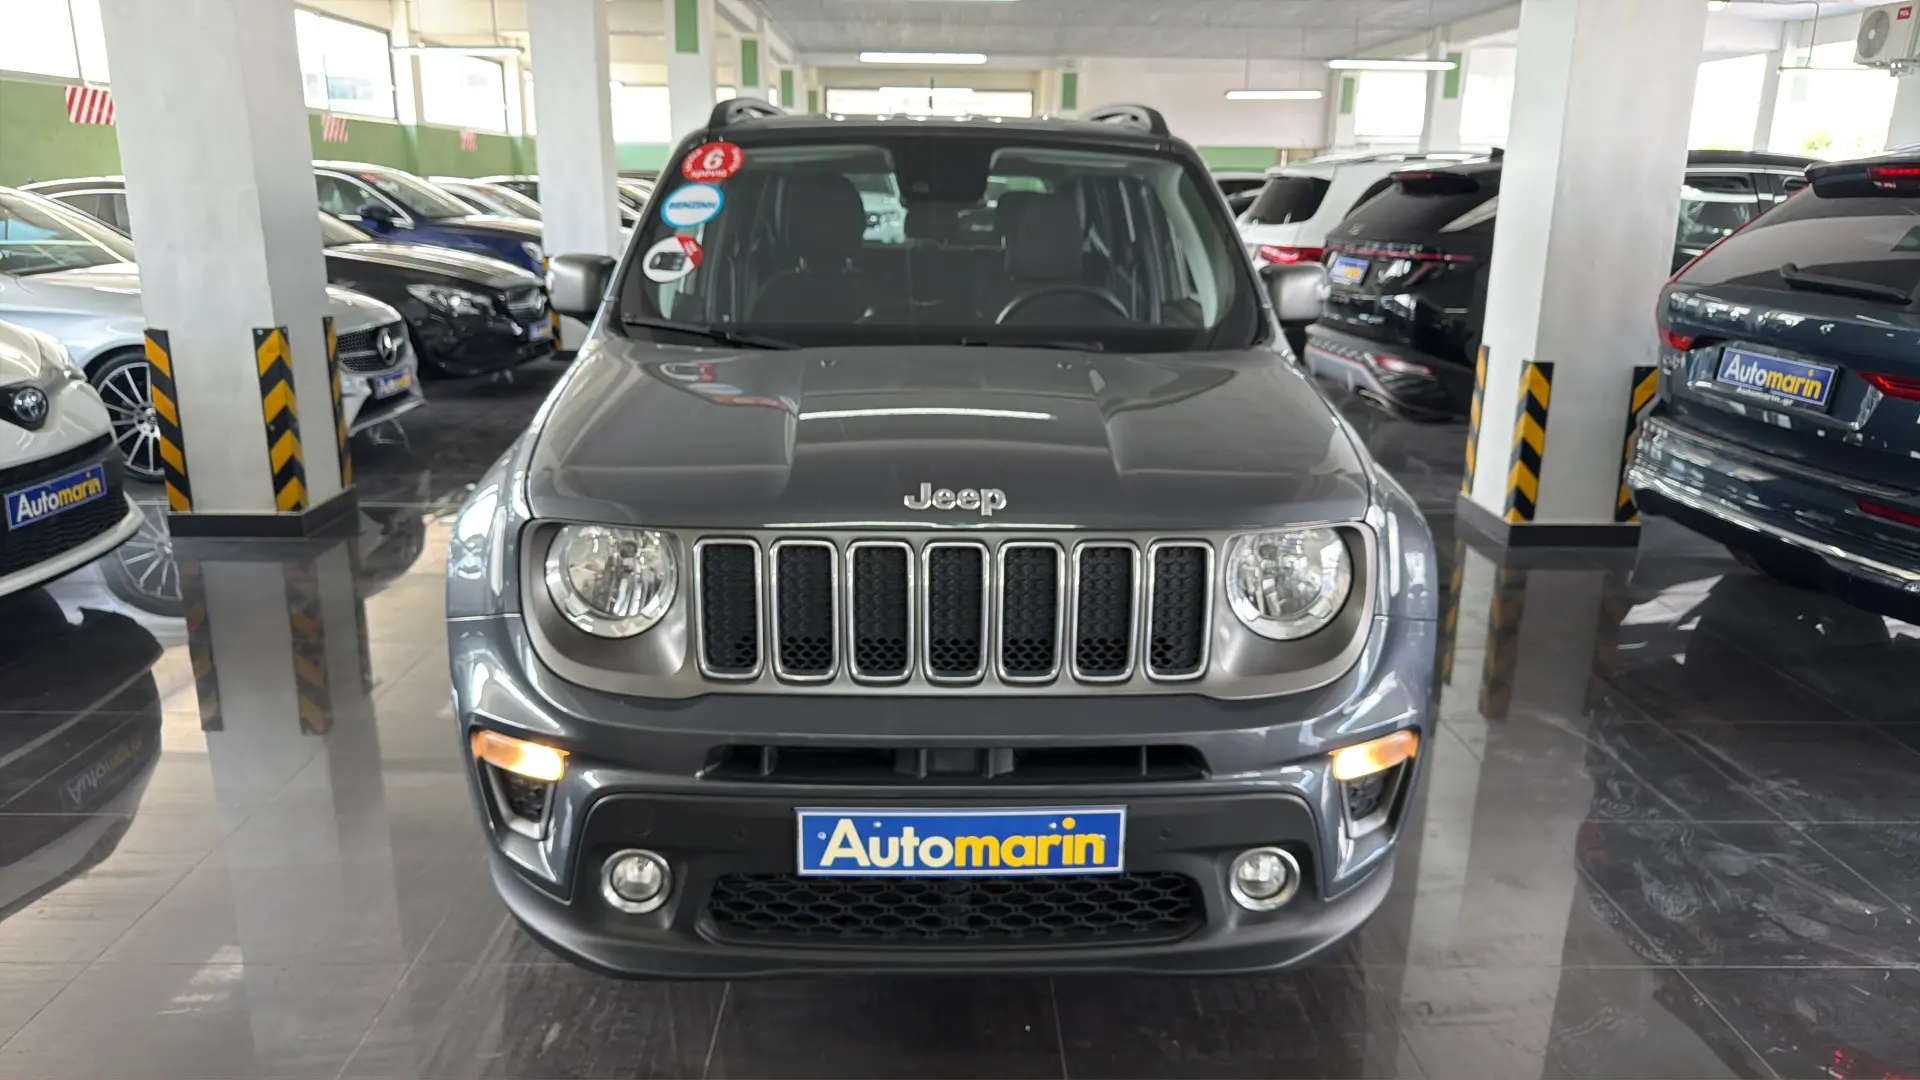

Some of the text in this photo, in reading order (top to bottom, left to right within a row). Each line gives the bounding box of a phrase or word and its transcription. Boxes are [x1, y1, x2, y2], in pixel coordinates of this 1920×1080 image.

[702, 147, 725, 170] 6
[1723, 353, 1823, 400] Automarin
[16, 471, 102, 522] Automarin
[903, 482, 1007, 517] Jeep
[819, 817, 1106, 868] Automarin
